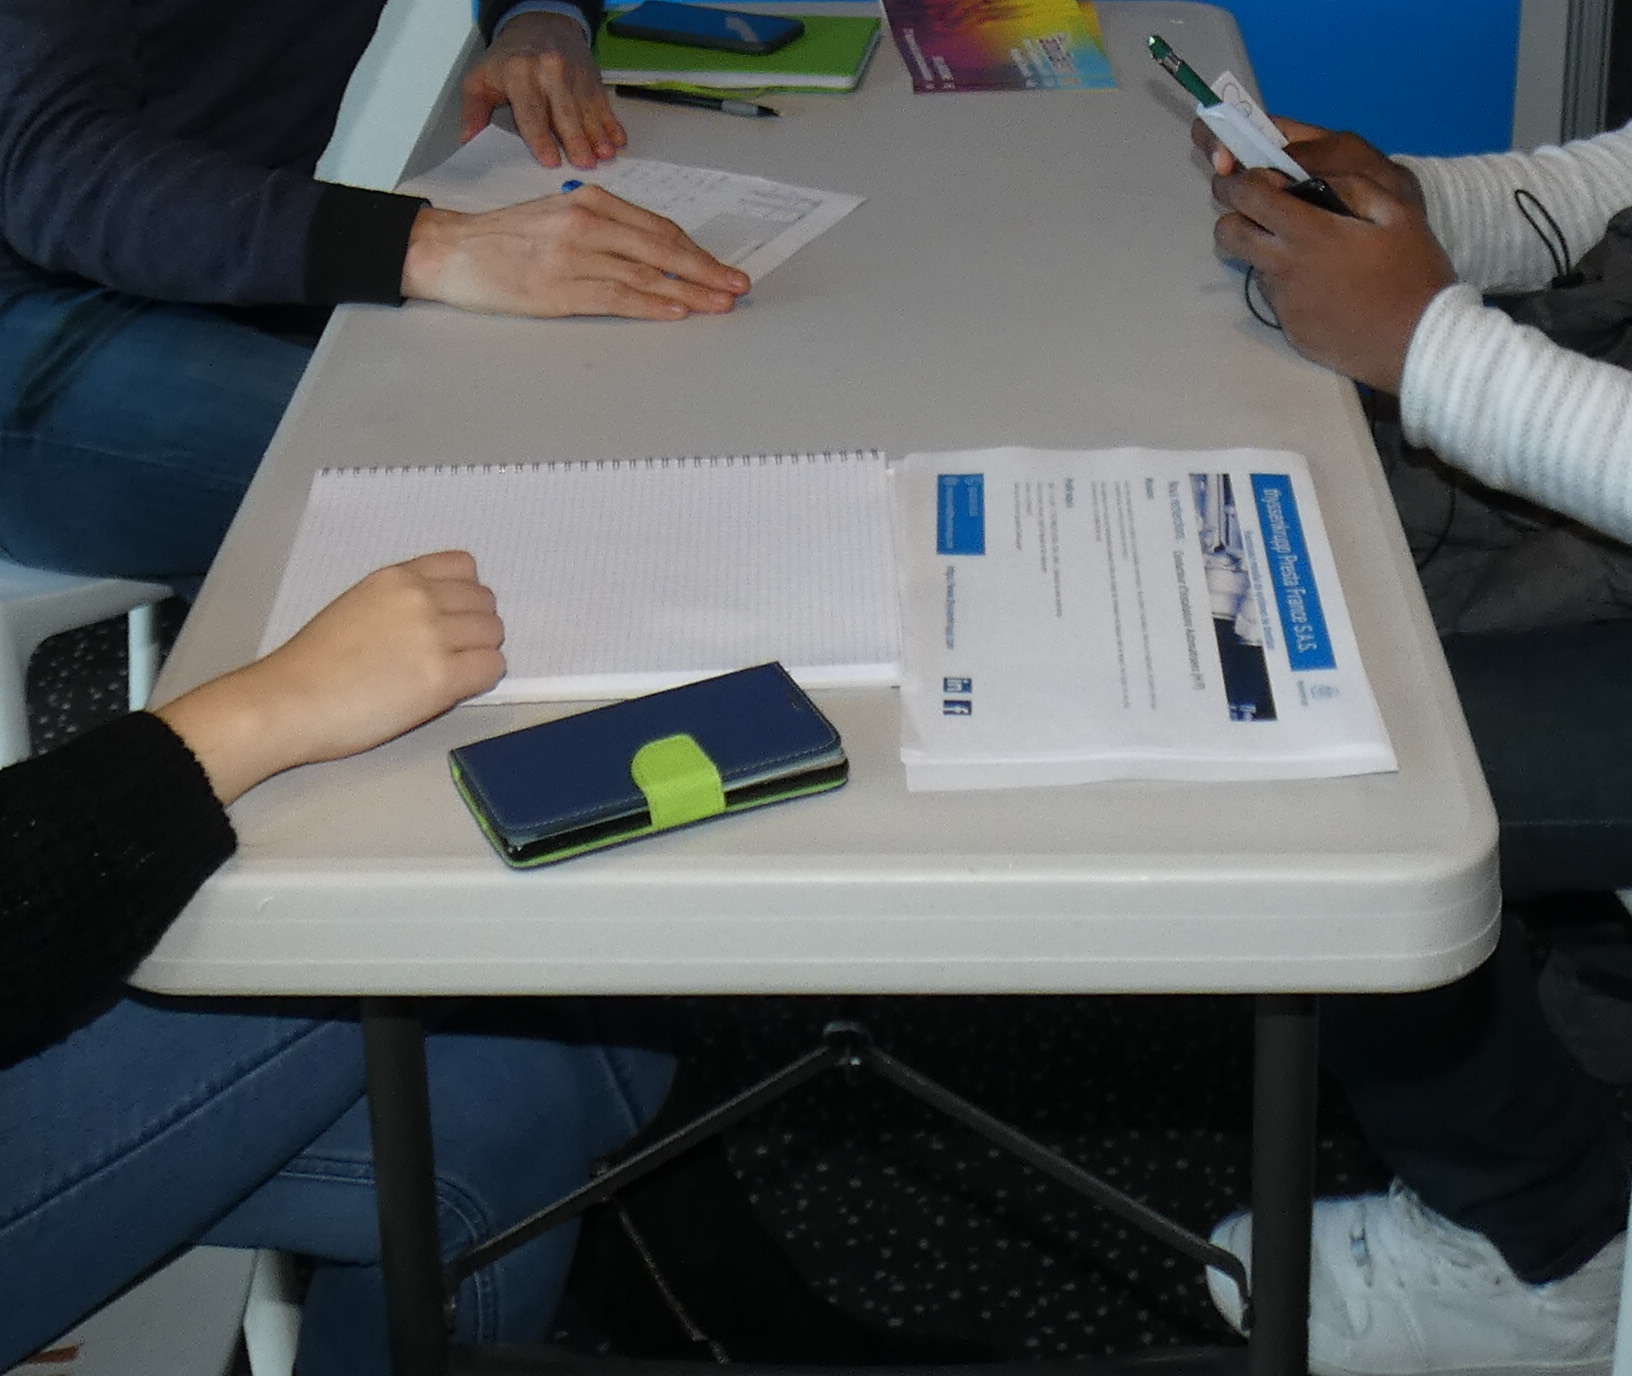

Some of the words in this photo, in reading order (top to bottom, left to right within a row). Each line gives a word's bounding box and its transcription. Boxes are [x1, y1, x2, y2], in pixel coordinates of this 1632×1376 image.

[1262, 487, 1292, 554] thyssenkrupp
[1278, 554, 1302, 588] Presta
[1285, 587, 1310, 623] France
